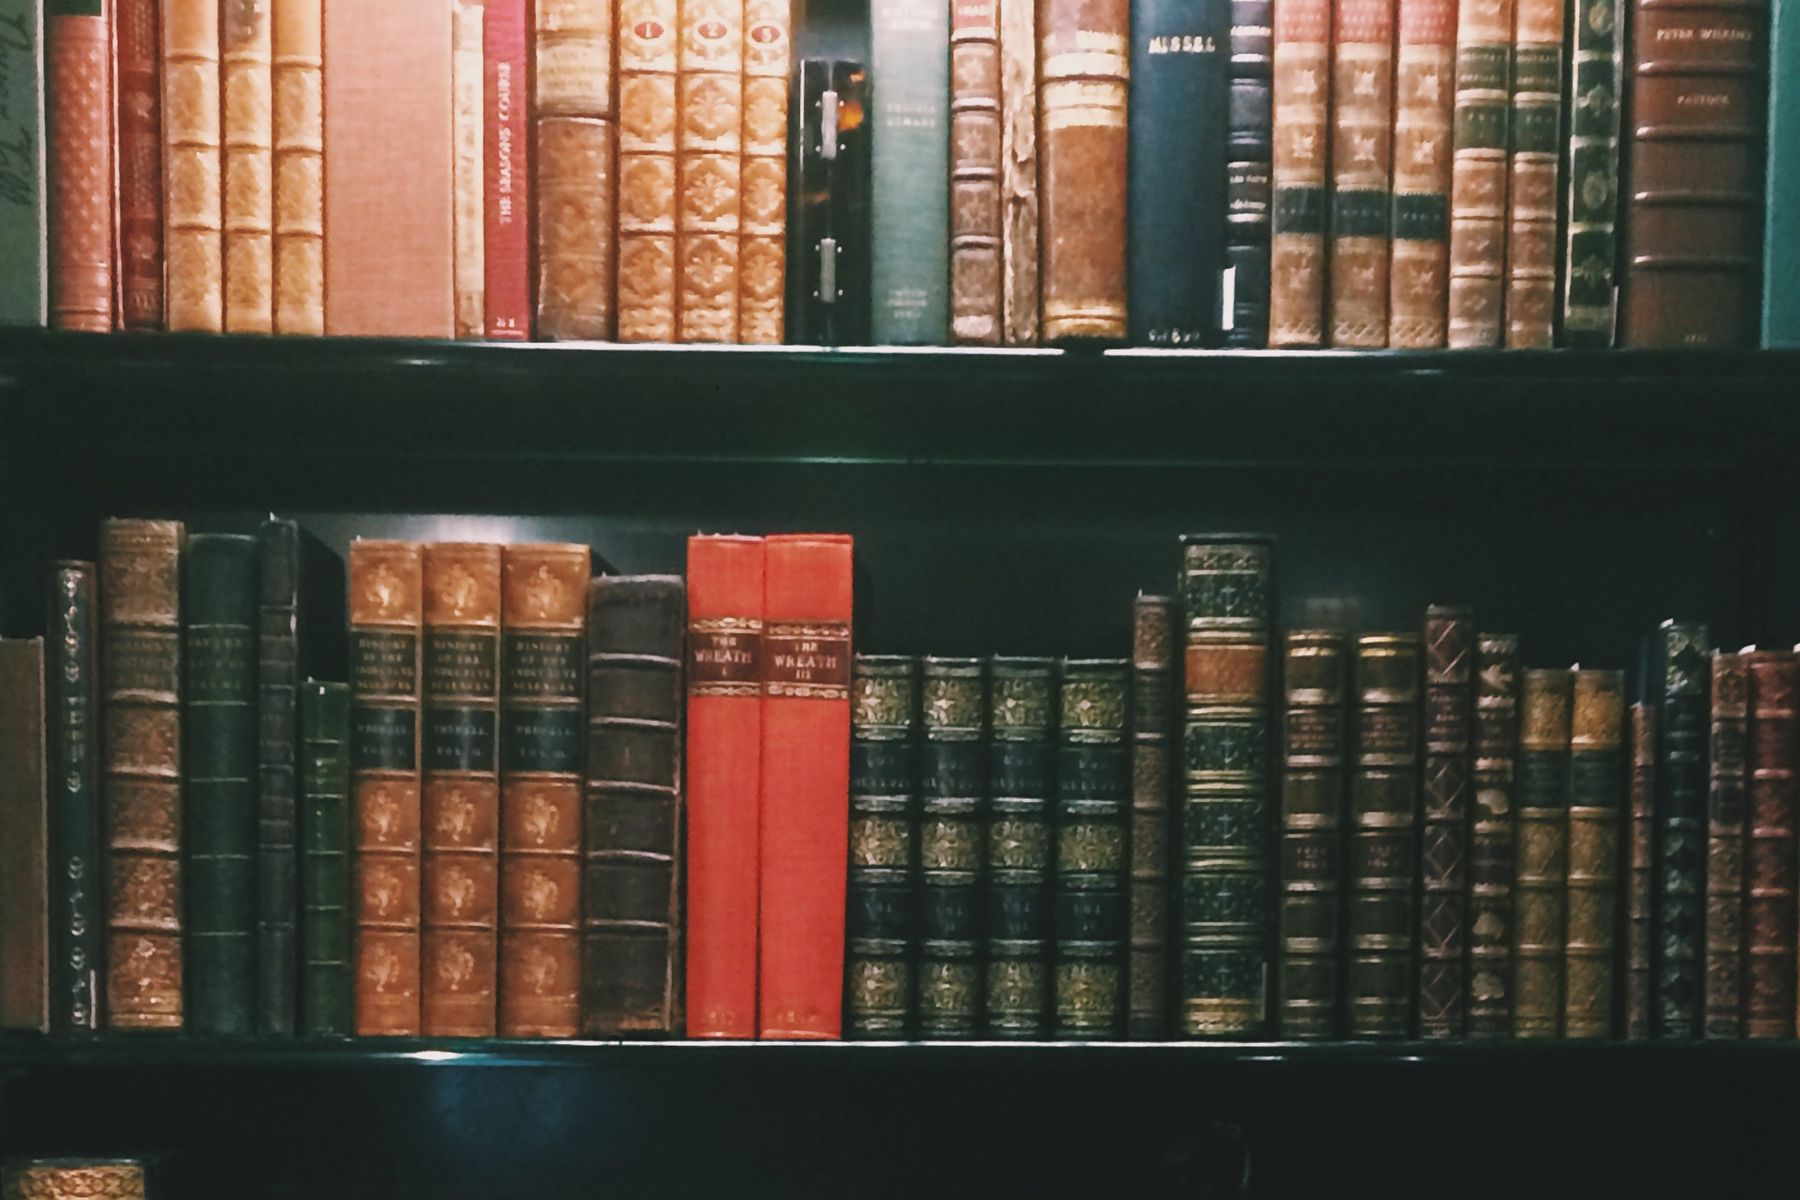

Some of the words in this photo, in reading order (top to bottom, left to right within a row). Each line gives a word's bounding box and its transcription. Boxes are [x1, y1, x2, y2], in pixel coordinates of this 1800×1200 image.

[711, 636, 737, 646] THE
[794, 642, 818, 652] THE
[694, 649, 752, 664] WREATH
[774, 655, 837, 668] WREATH
